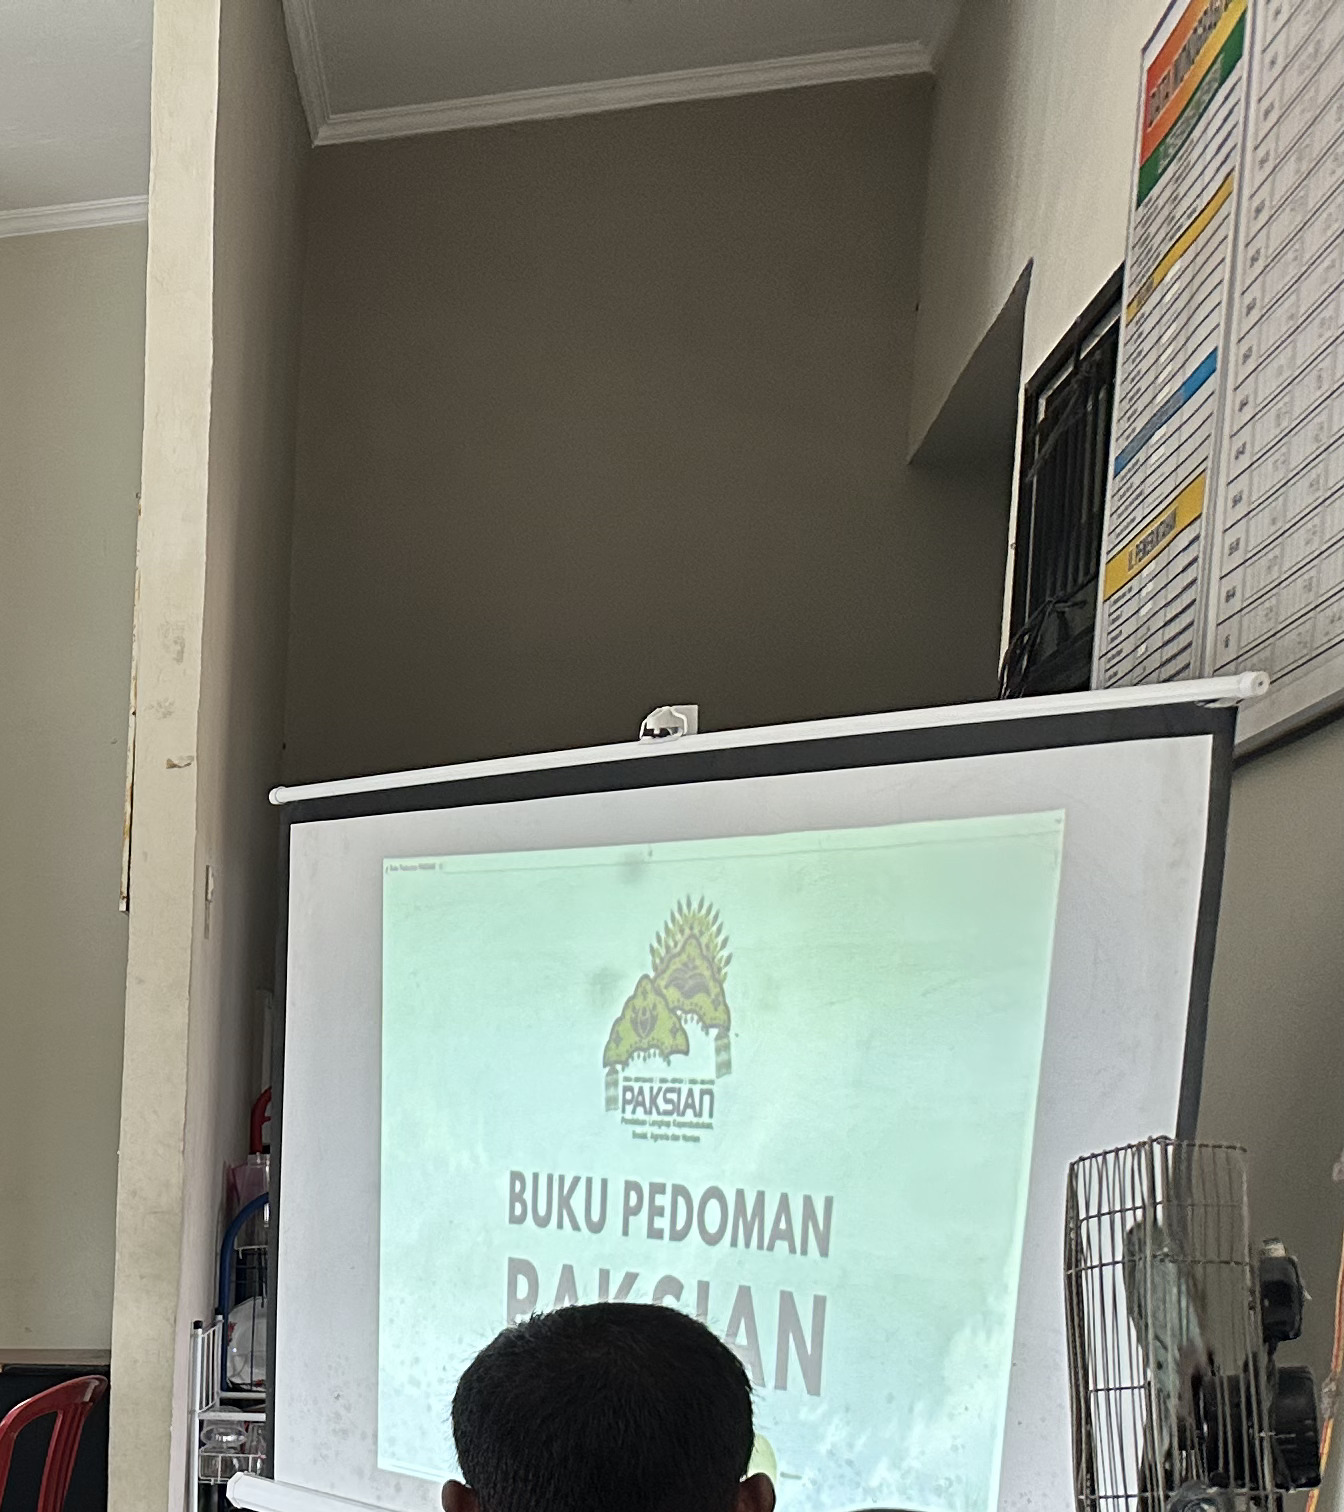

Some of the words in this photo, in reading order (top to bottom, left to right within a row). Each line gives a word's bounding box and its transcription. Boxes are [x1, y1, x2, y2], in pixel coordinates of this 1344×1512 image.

[621, 1085, 715, 1119] PAKSIAN
[507, 1170, 609, 1235] BUKU
[622, 1179, 834, 1258] PEDOMAN
